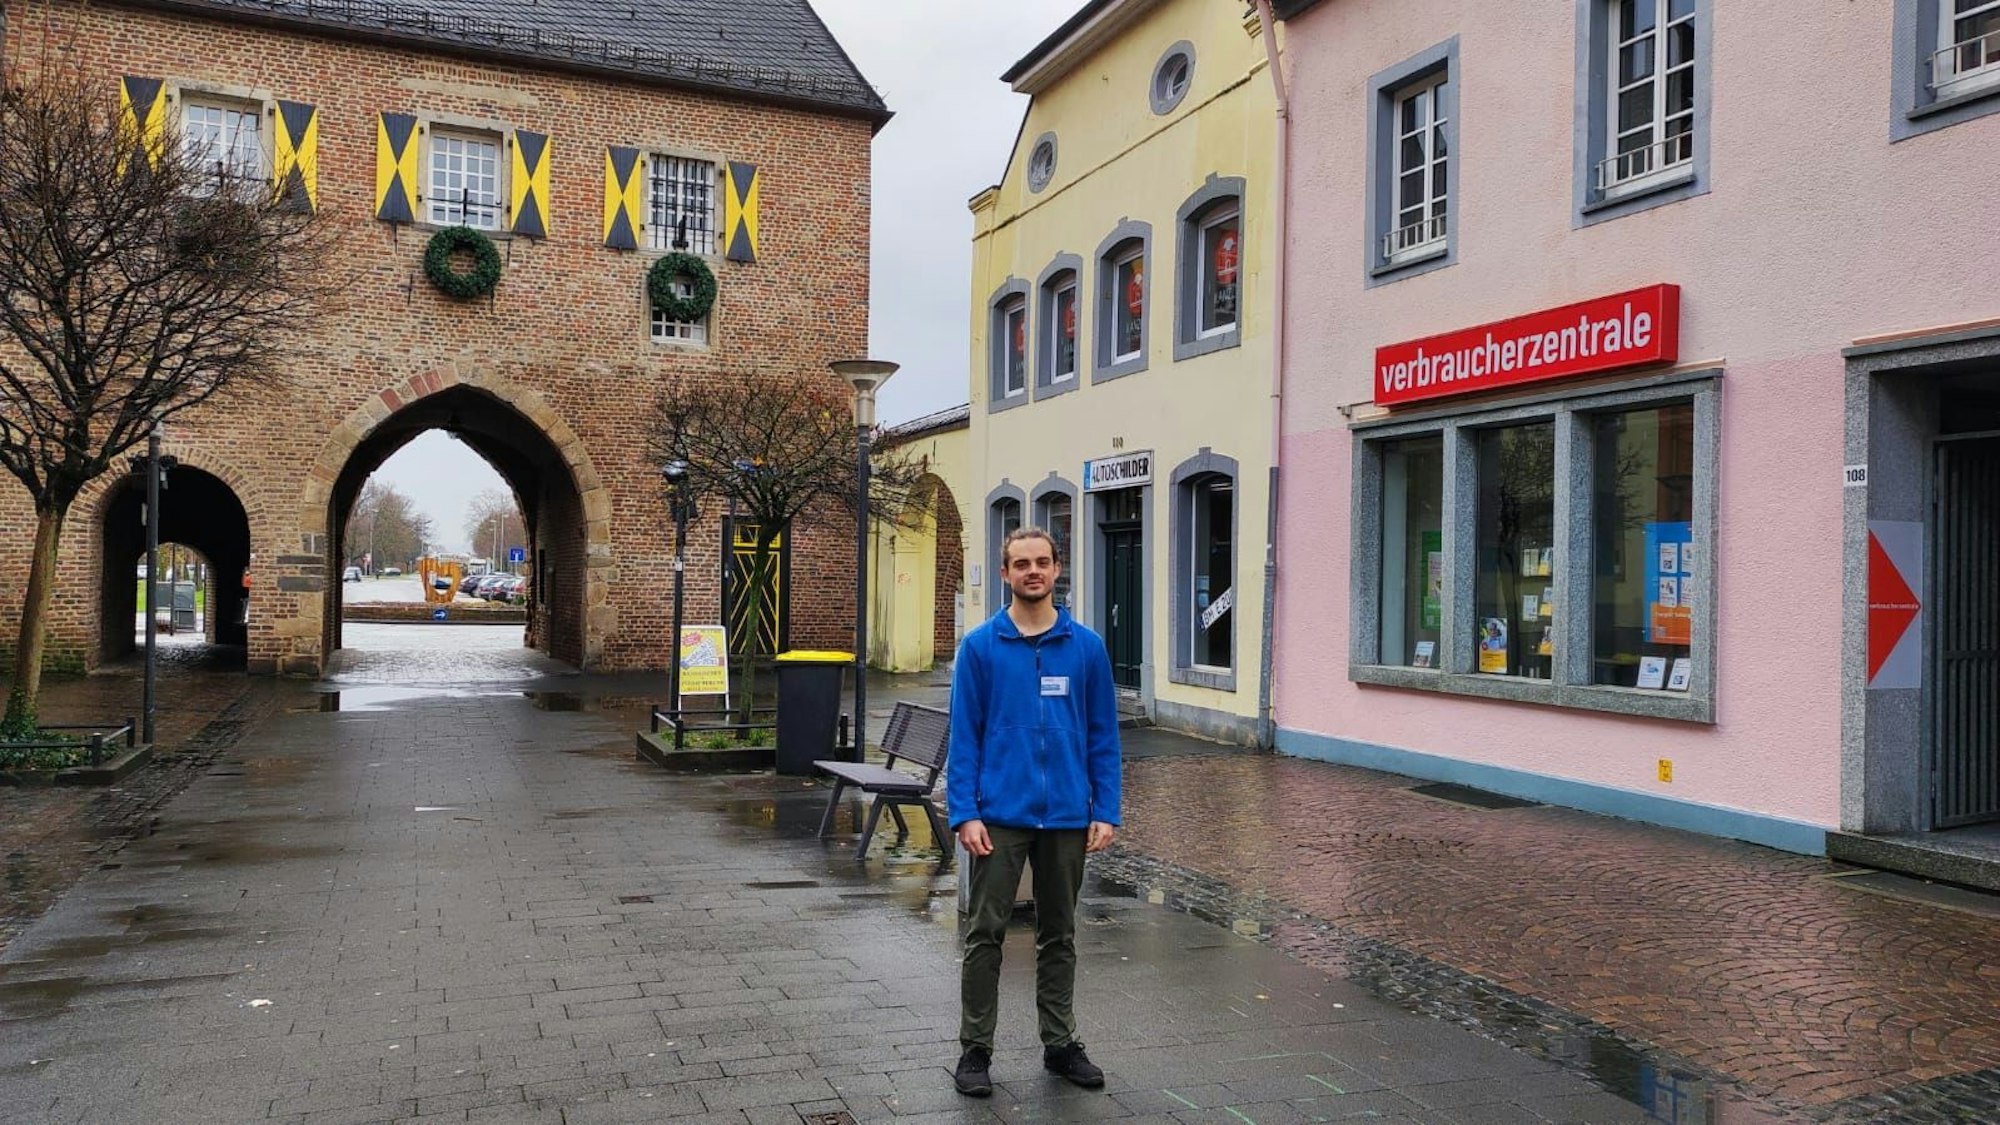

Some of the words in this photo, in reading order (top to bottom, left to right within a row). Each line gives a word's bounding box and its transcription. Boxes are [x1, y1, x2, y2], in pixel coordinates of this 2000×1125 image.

[1381, 302, 1651, 393] verbraucherzentrale
[1092, 457, 1149, 482] AUTOSCHILDER
[1846, 469, 1866, 482] 108
